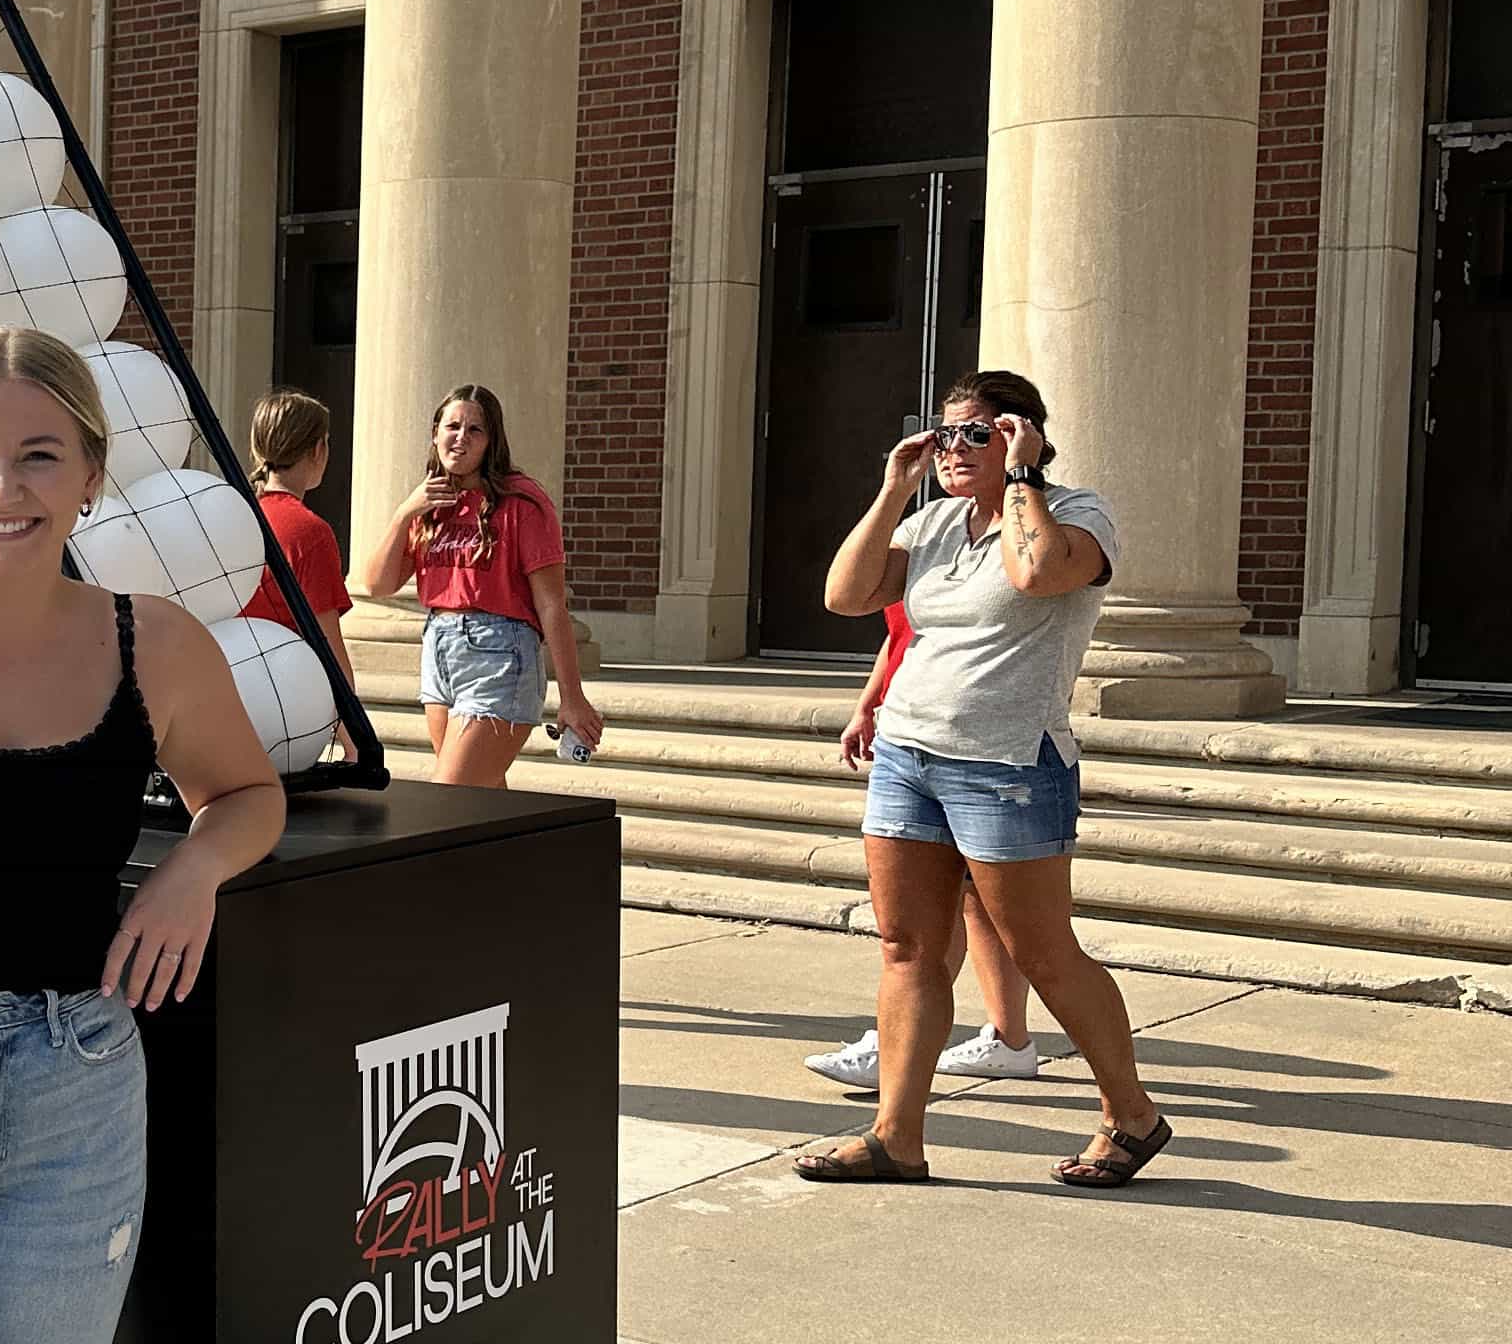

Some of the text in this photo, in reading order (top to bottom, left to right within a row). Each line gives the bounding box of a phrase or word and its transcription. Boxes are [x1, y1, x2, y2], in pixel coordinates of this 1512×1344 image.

[354, 1147, 554, 1273] RALLY AT THE
